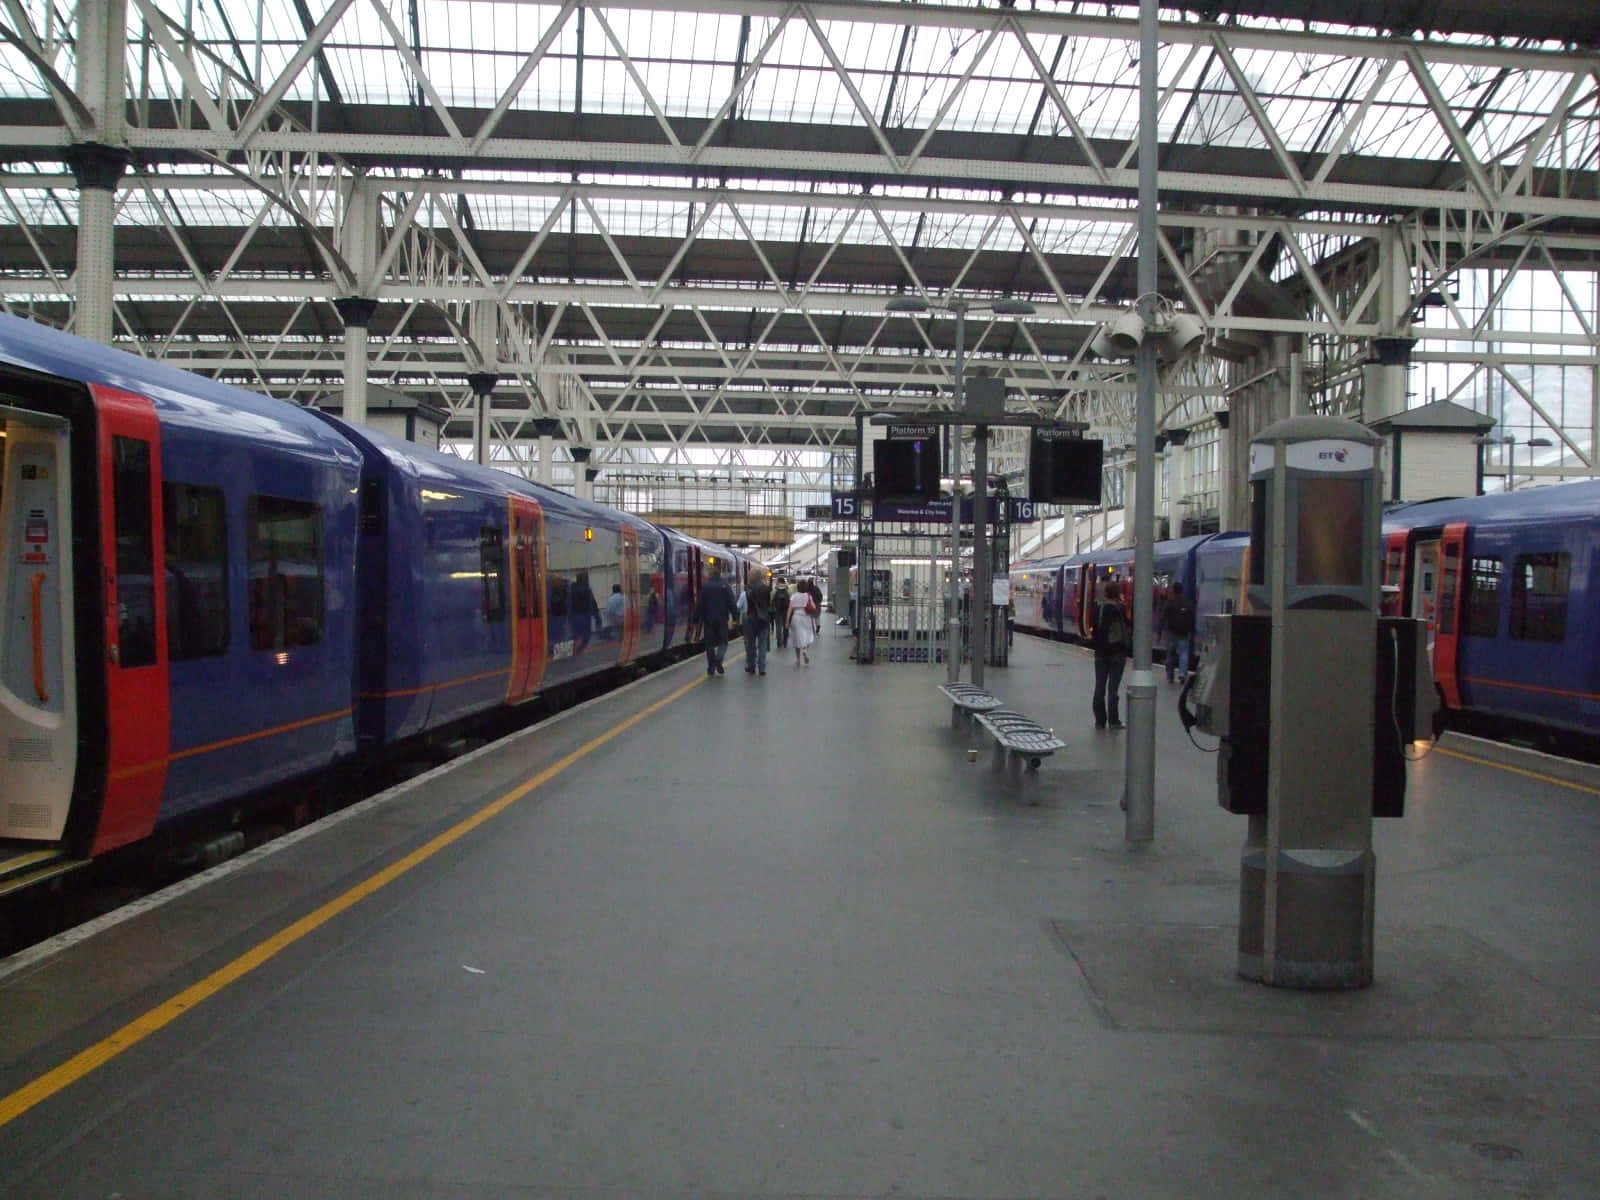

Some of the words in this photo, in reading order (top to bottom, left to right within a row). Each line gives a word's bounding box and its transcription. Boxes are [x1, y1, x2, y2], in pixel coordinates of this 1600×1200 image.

[891, 425, 924, 435] Platform
[926, 425, 936, 435] 15
[1036, 428, 1069, 438] Platform
[1318, 452, 1333, 460] BT
[834, 497, 855, 515] 15
[1015, 502, 1033, 519] 16
